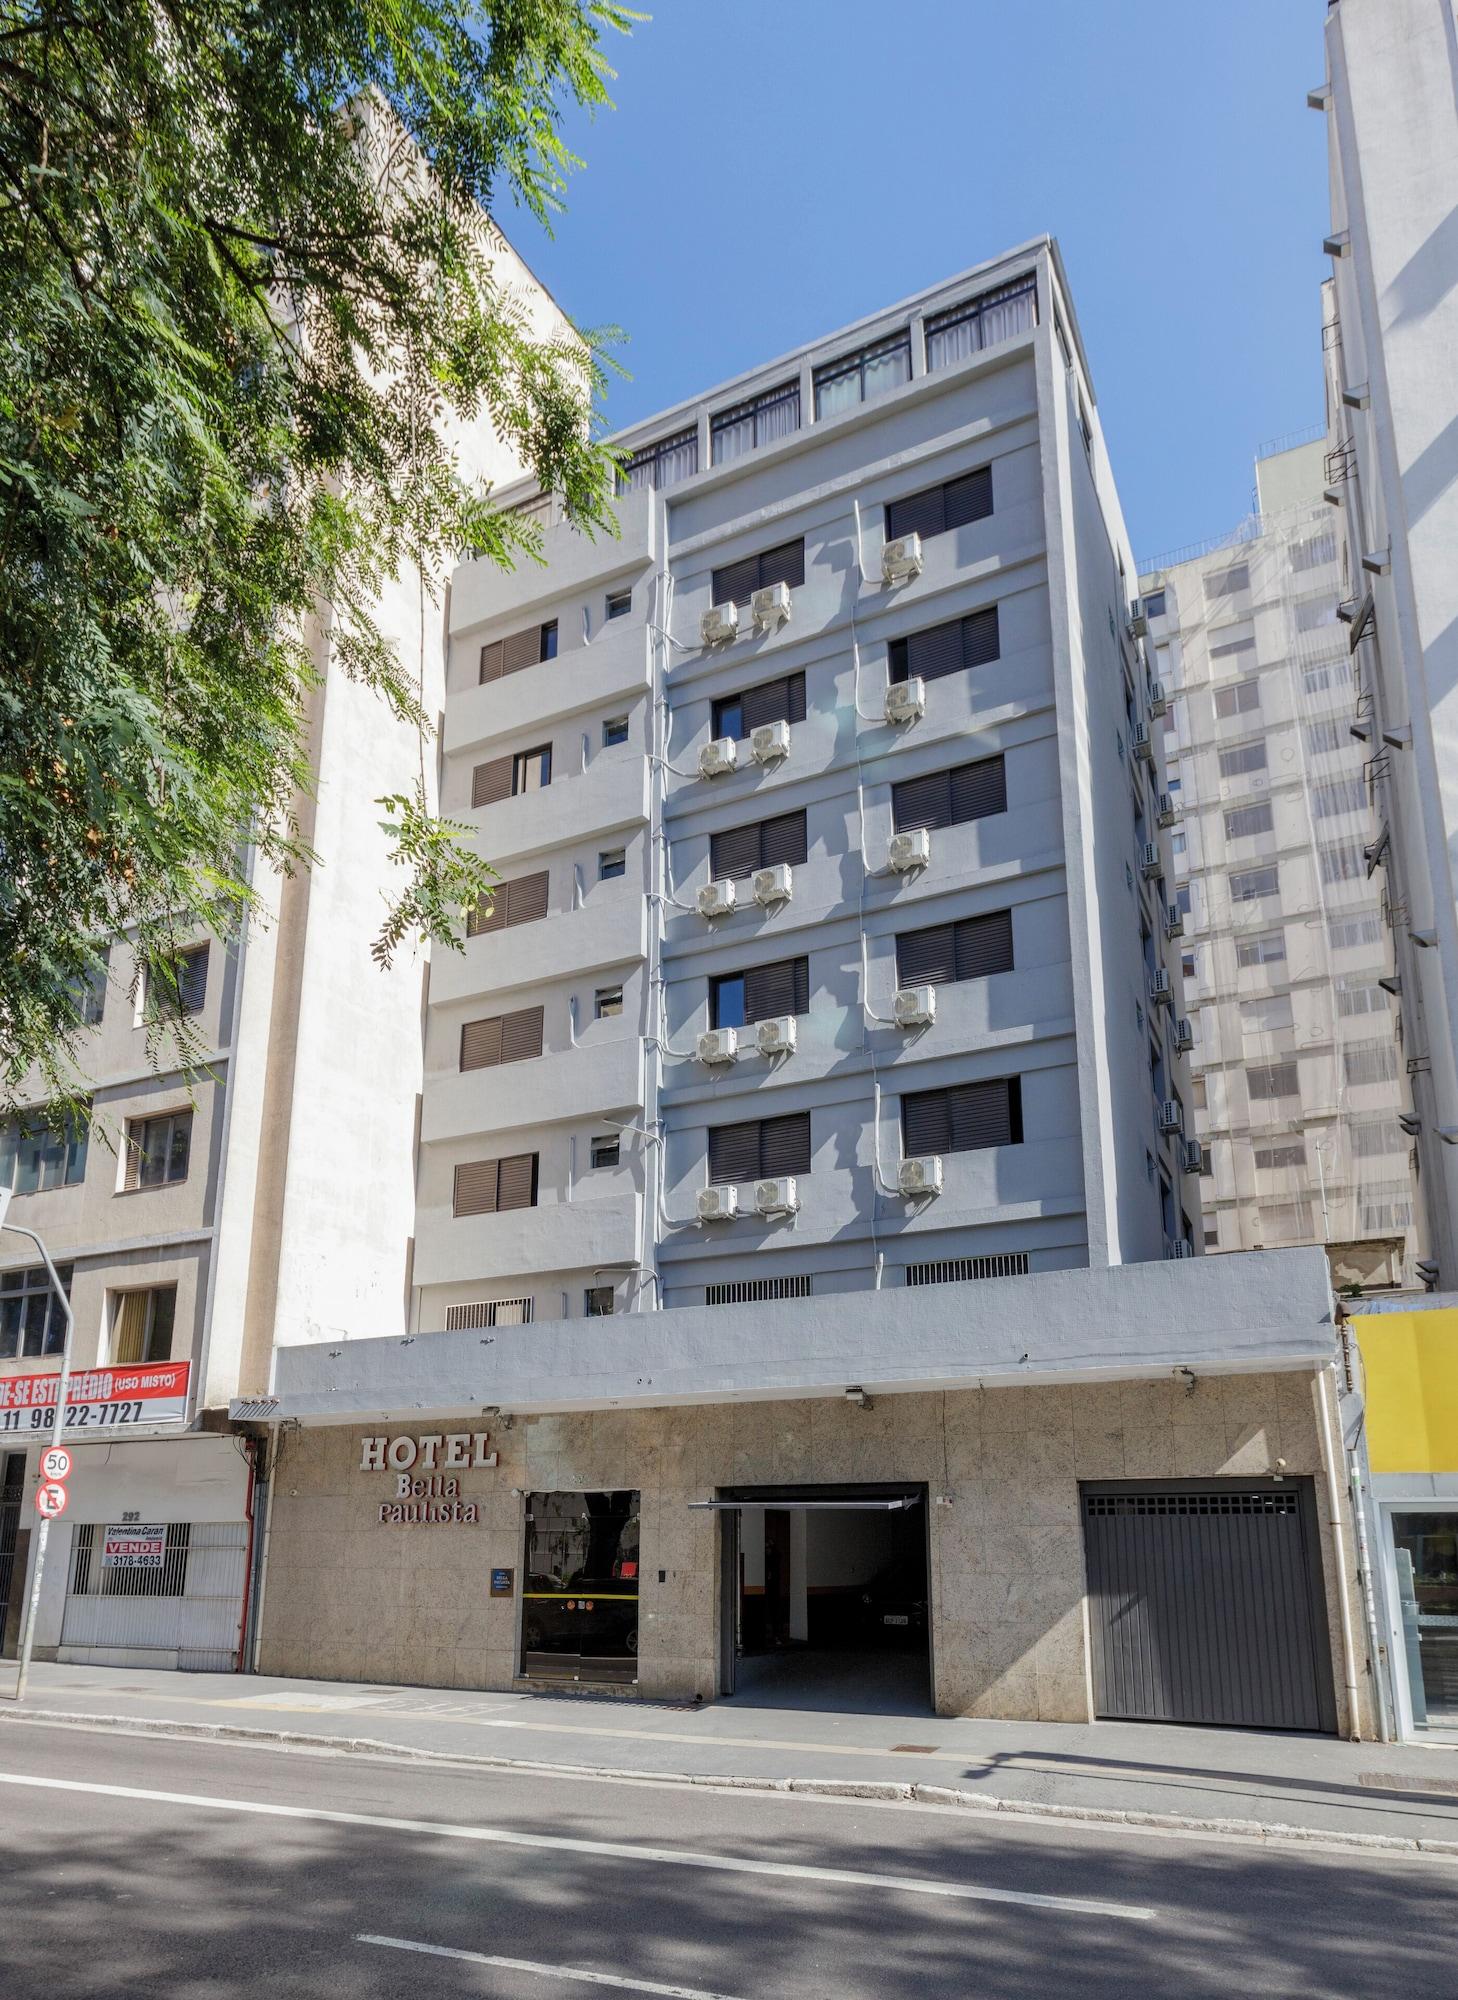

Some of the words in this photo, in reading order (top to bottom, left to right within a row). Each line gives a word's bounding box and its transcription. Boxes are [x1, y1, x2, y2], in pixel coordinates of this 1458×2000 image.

[115, 1376, 138, 1392] (USO
[141, 1373, 176, 1389] MISTO)
[4, 1410, 20, 1430] 11
[31, 1401, 143, 1428] 9822-7727
[359, 1432, 498, 1471] HOTEL
[47, 1454, 68, 1471] 50
[396, 1473, 459, 1498] Bella
[122, 1511, 140, 1521] 292
[377, 1501, 479, 1523] Paulista
[108, 1542, 160, 1553] VENDE
